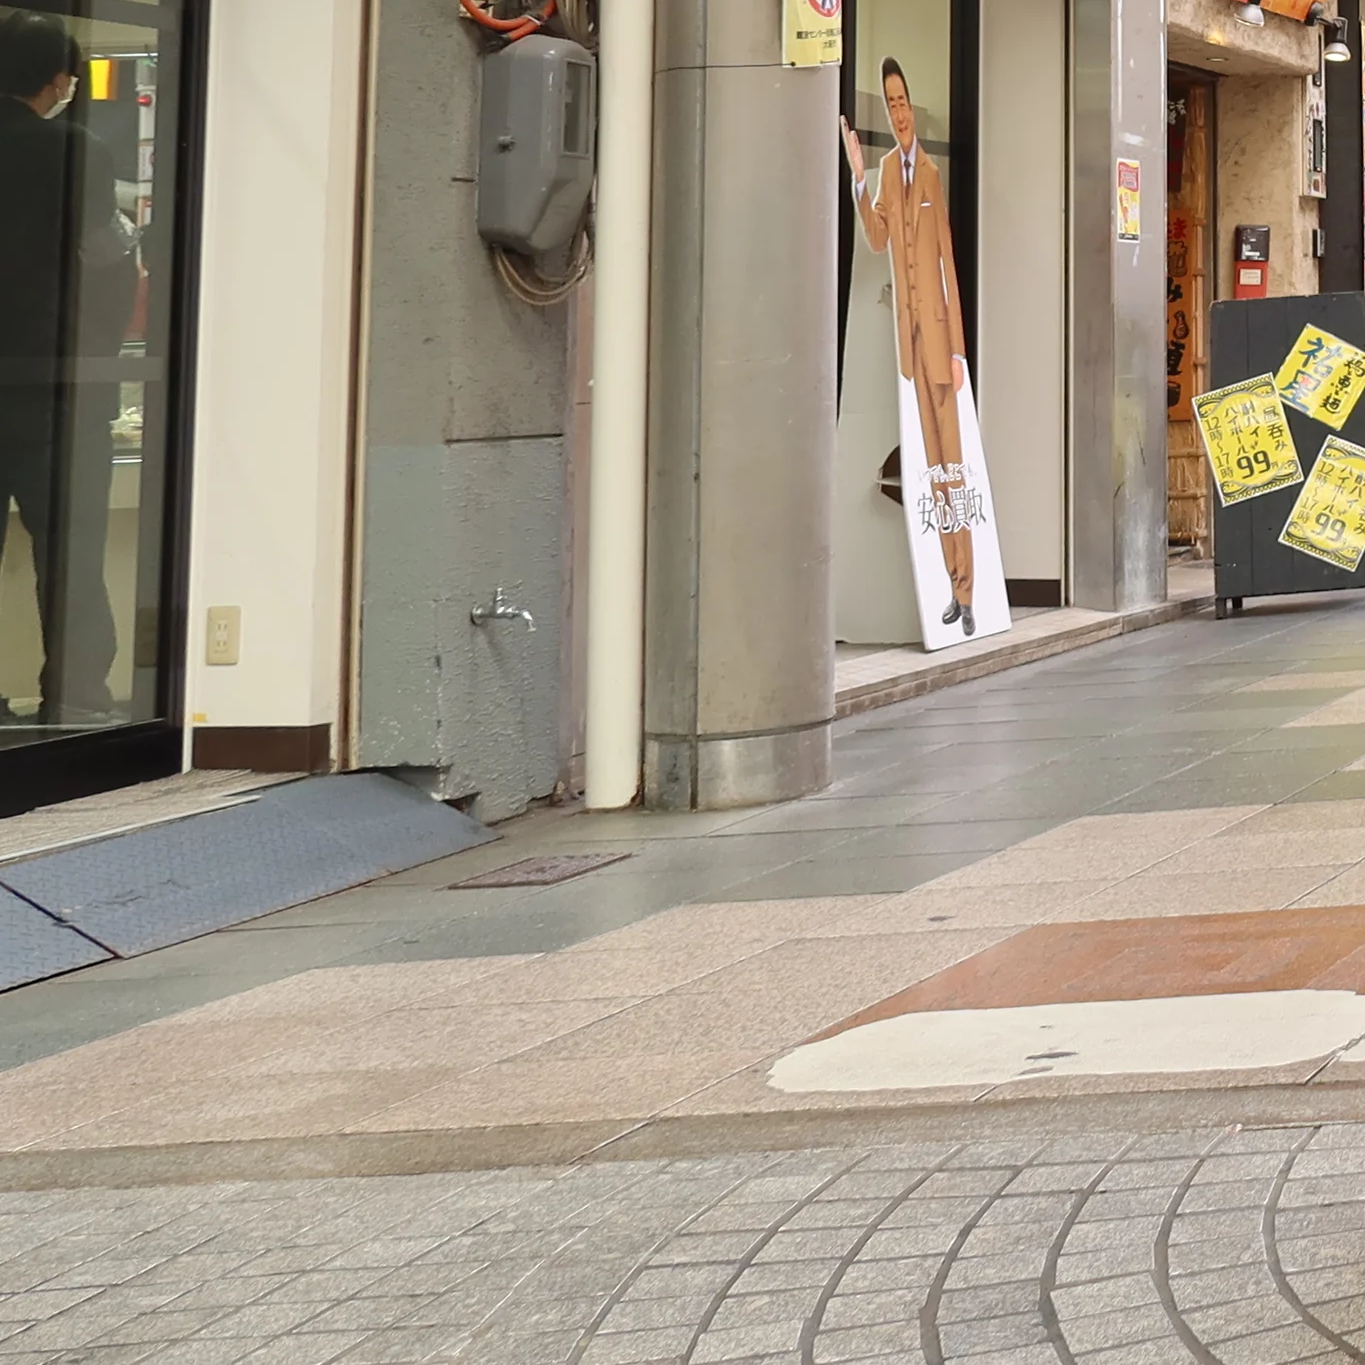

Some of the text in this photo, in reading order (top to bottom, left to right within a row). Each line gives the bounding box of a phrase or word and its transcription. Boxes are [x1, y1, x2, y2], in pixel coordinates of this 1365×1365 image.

[1263, 405, 1289, 452] 昼呑み
[917, 485, 987, 536] 安心買取
